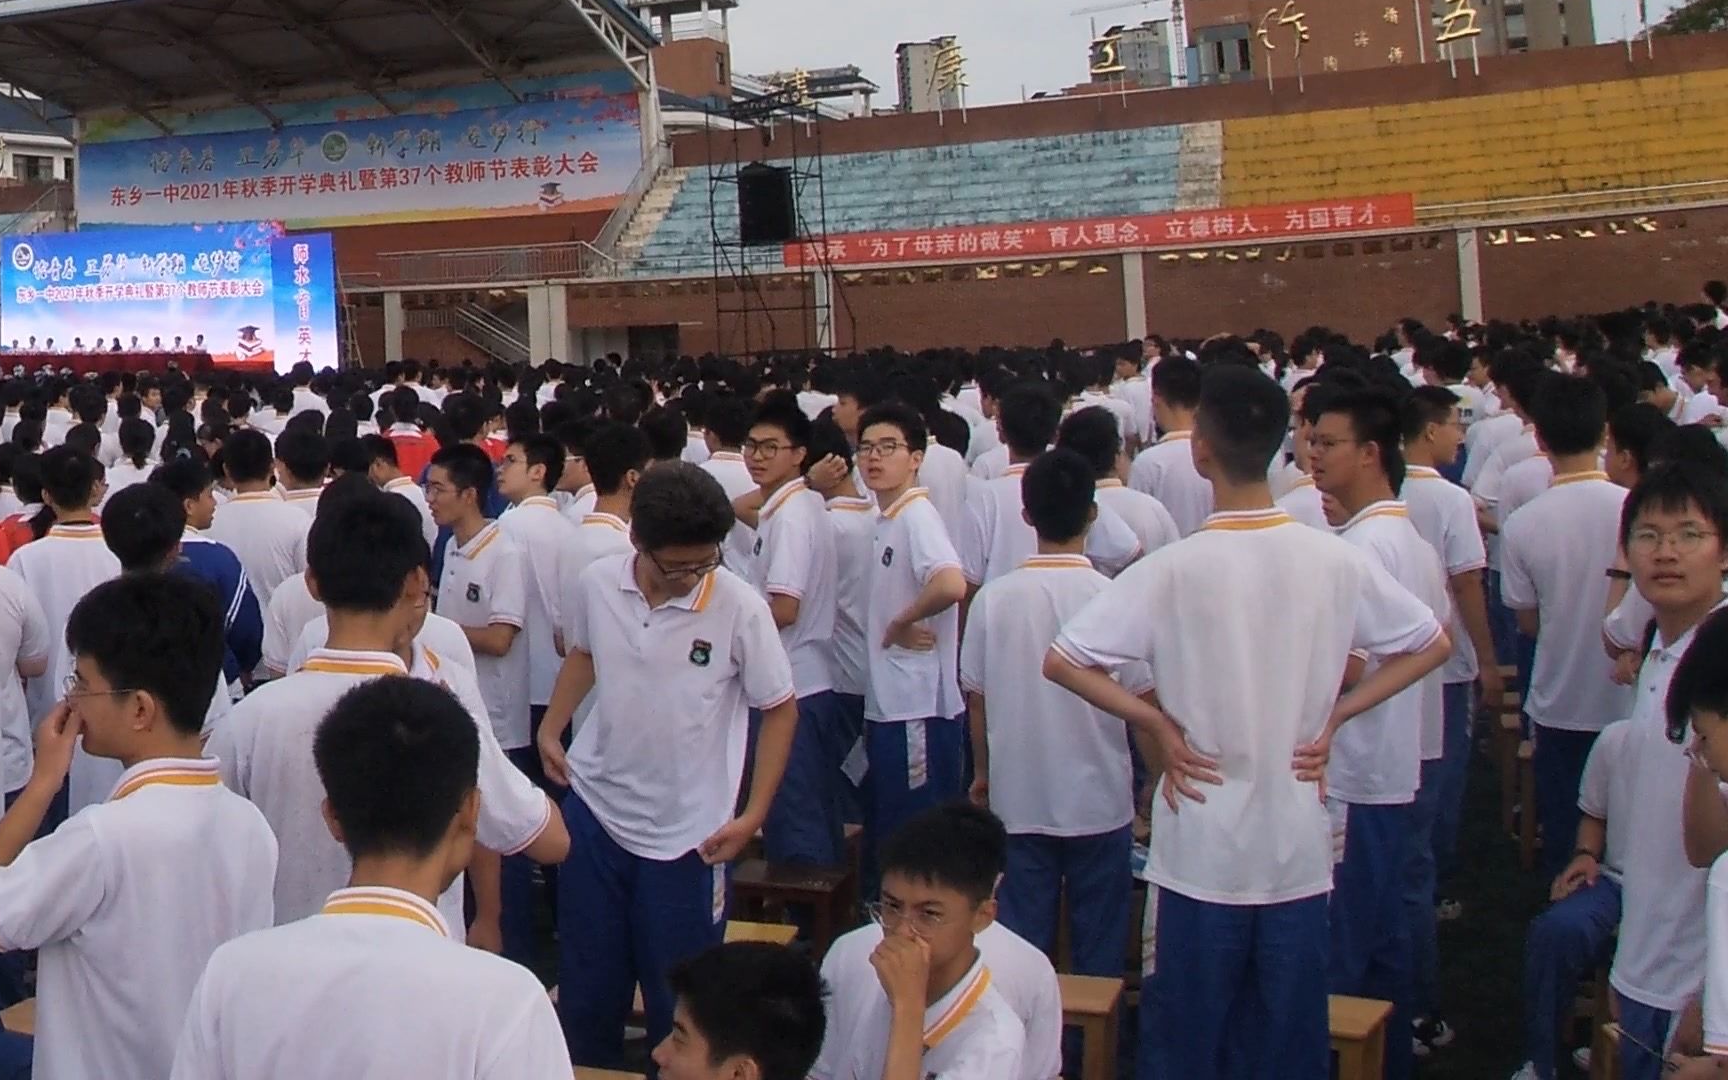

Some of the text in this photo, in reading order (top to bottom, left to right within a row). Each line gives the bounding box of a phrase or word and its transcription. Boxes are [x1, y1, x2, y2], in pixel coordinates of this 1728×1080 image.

[365, 129, 442, 160] 新学期
[108, 151, 599, 208] 东乡一中2021年秋季开学典礼暨第37个教师节表彰大会
[16, 279, 265, 304] 东乡一中2021年秋季开学典礼暨第37个教师节表彰大会
